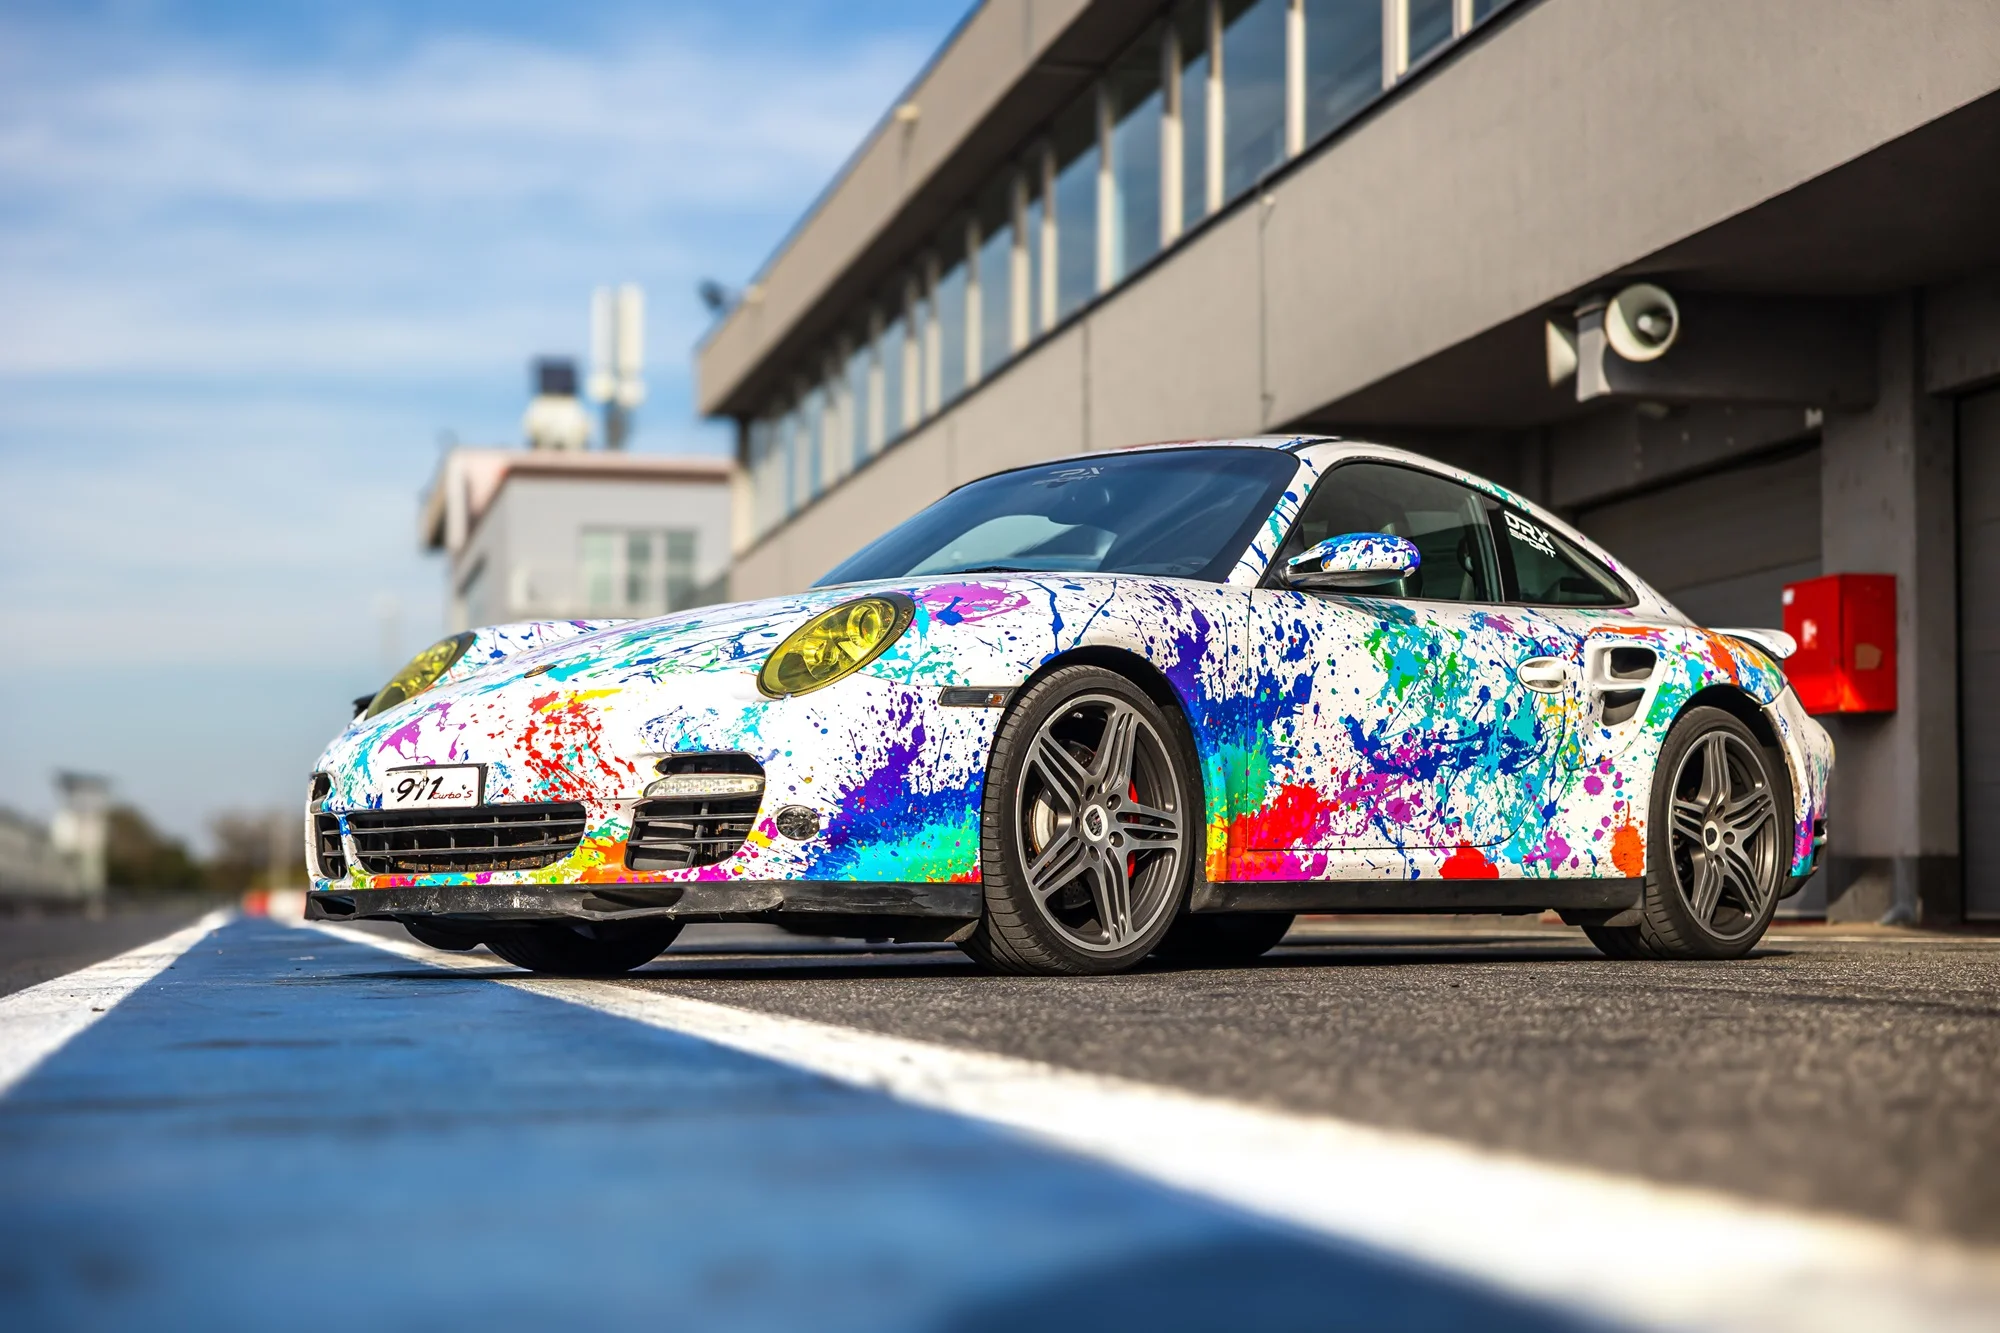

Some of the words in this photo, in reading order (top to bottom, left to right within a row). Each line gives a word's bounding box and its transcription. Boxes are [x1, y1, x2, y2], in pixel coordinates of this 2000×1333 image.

[1503, 510, 1554, 550] DRX
[1508, 527, 1556, 558] SPORT
[397, 776, 444, 802] 911
[464, 790, 473, 799] S
